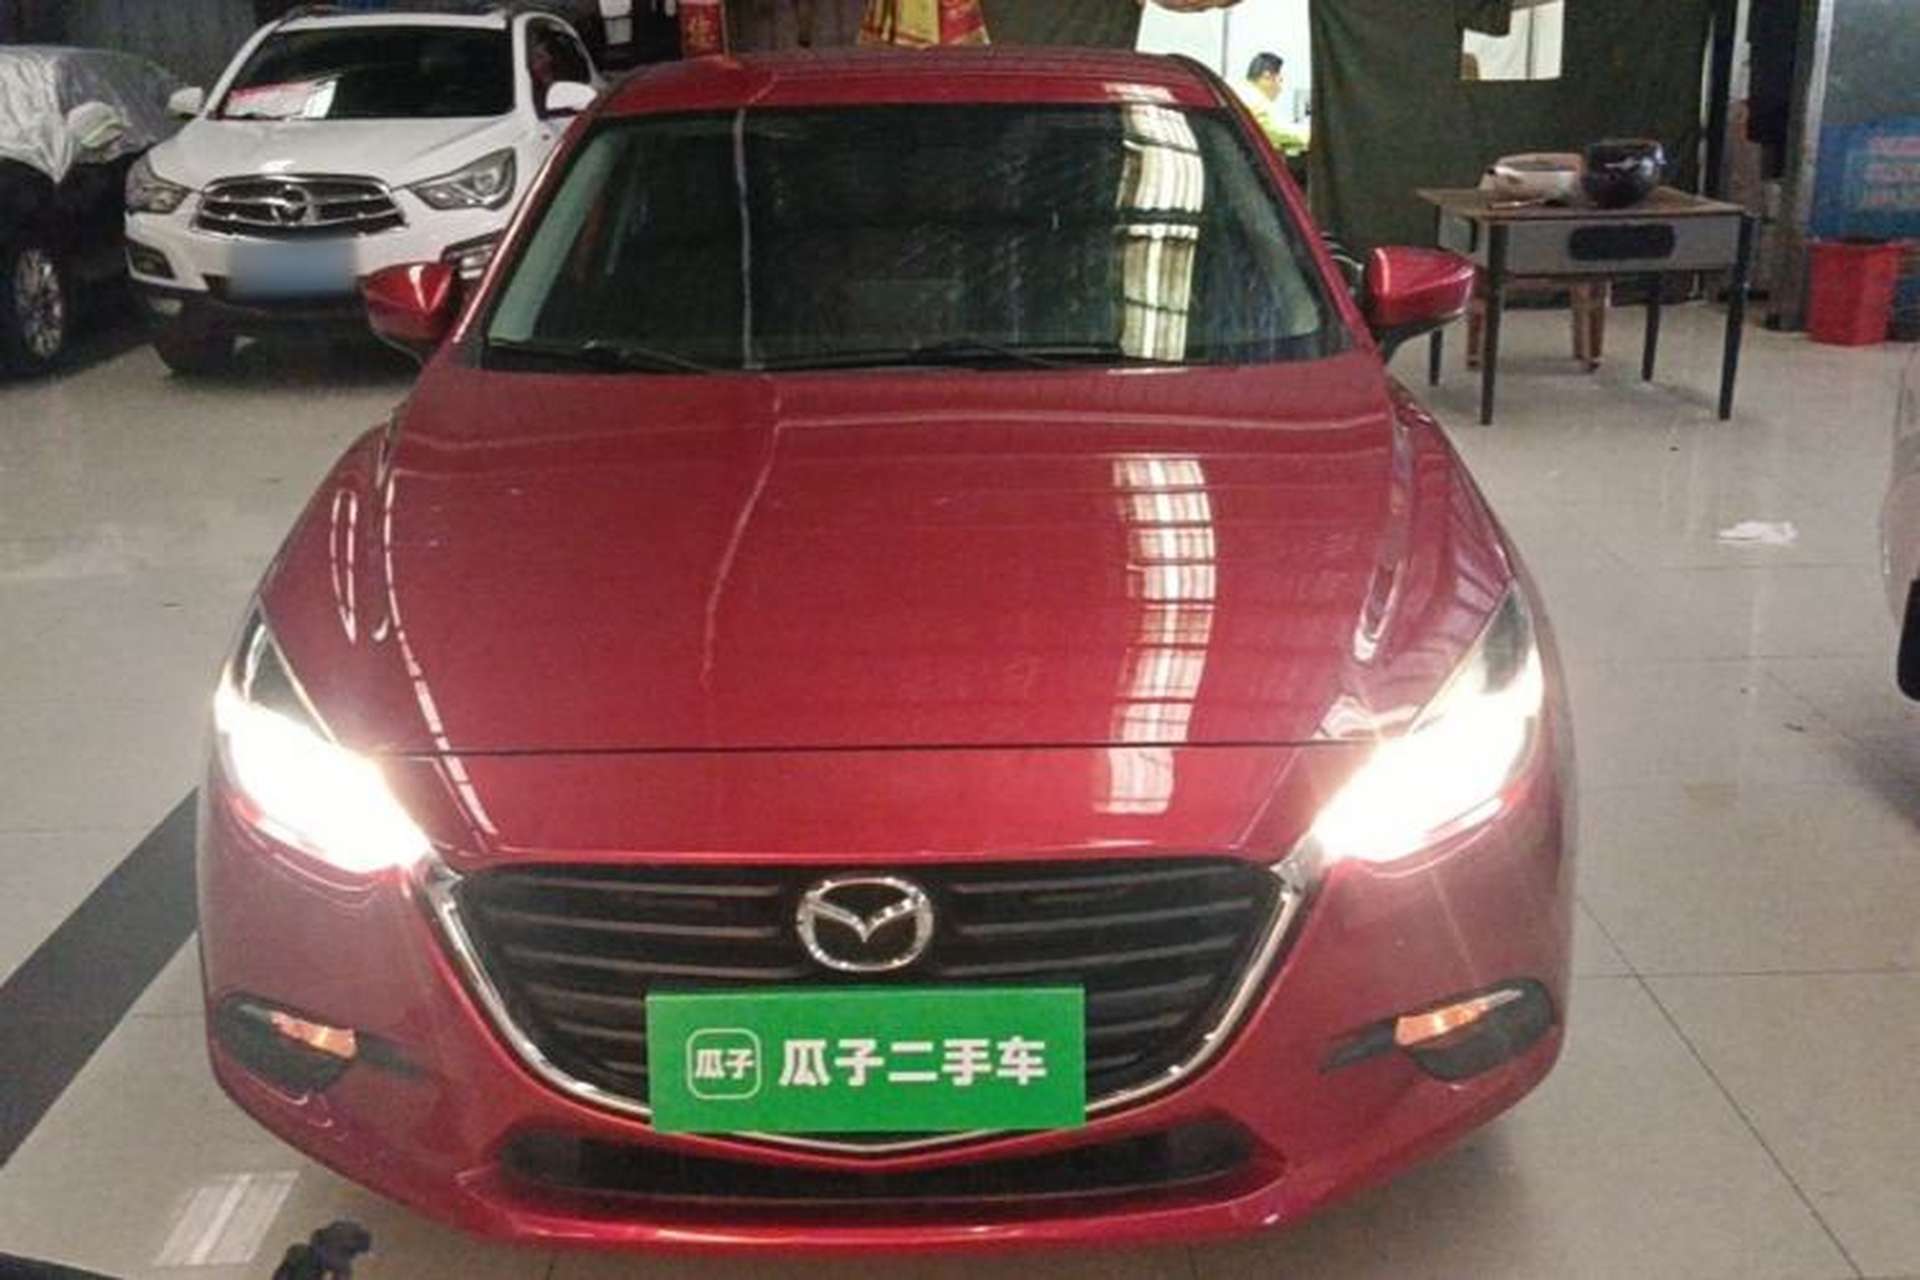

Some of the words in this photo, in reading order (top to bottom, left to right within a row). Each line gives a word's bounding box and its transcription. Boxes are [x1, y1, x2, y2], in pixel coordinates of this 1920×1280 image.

[695, 1048, 754, 1079] 瓜子
[778, 1036, 1048, 1087] 瓜子二手车
